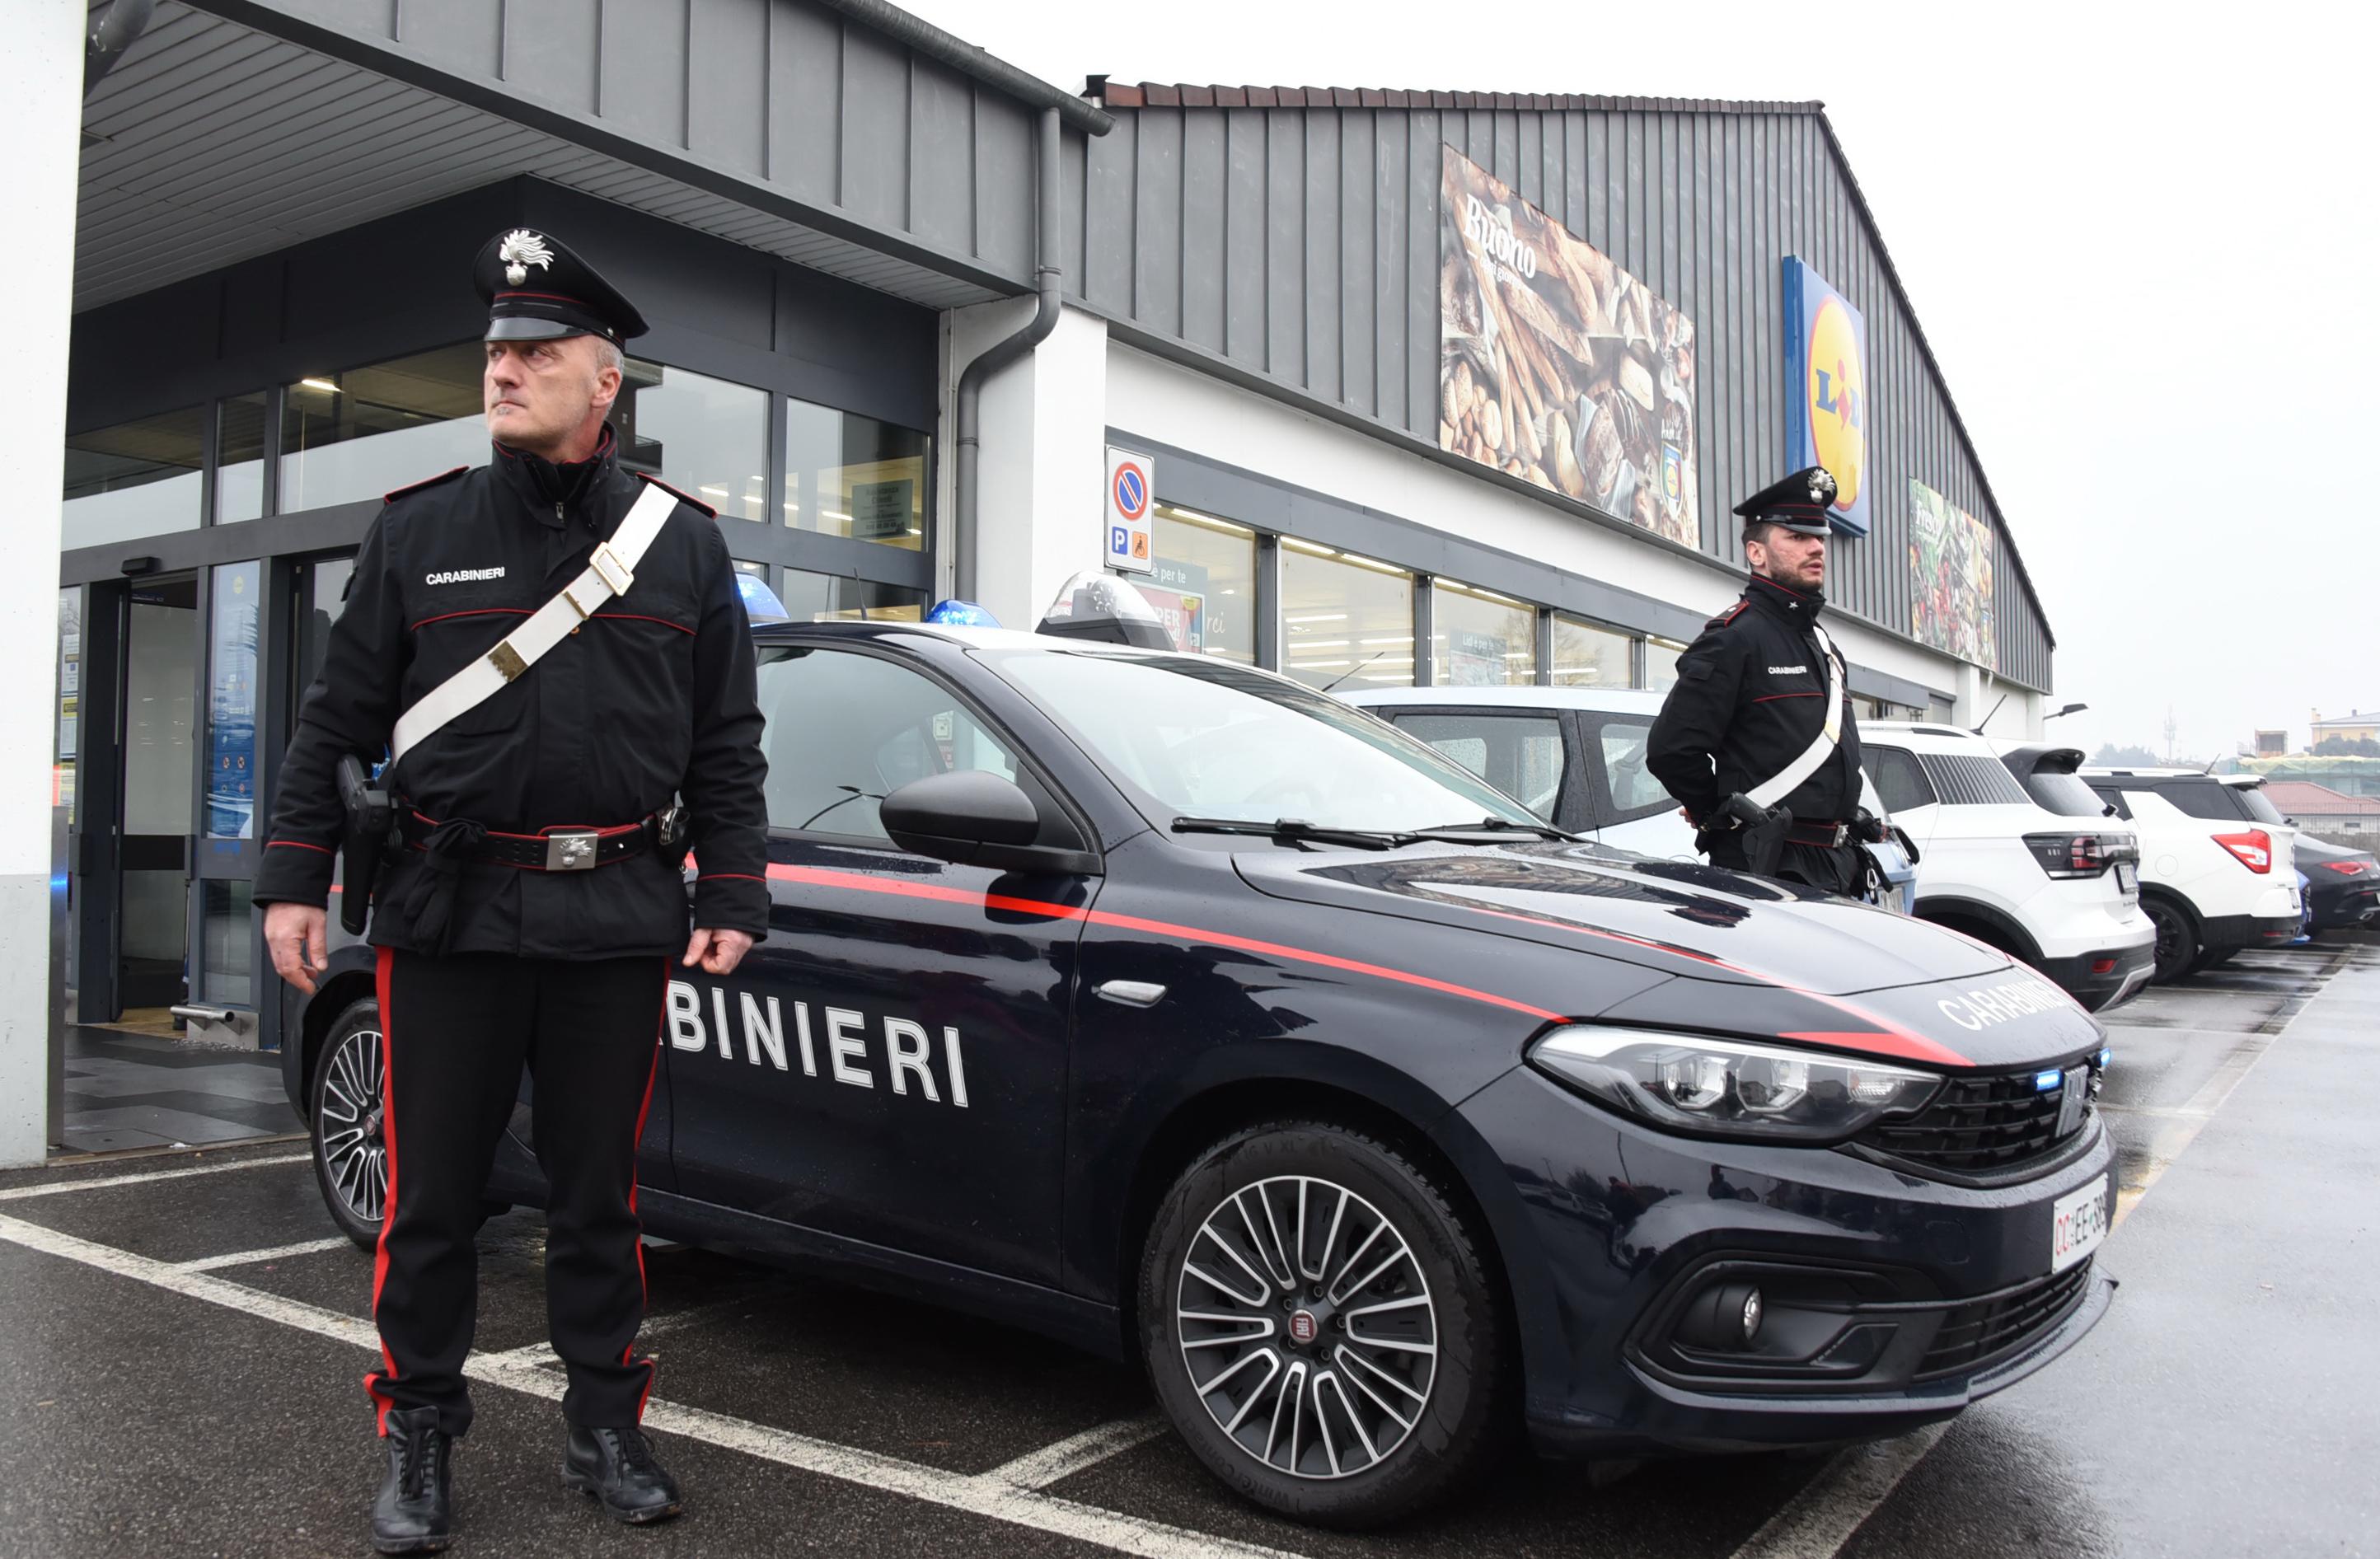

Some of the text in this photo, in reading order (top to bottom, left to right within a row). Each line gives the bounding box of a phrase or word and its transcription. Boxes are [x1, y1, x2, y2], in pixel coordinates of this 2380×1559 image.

[1464, 193, 1536, 279] Buono
[1115, 530, 1126, 551] P
[425, 566, 505, 585] CARABINIERI
[1160, 567, 1175, 582] per
[1178, 571, 1187, 584] te
[659, 981, 968, 1108] BINIERI
[2056, 1214, 2070, 1257] CC
[2076, 1202, 2089, 1245] EE
[1295, 1318, 1309, 1337] FIAT
